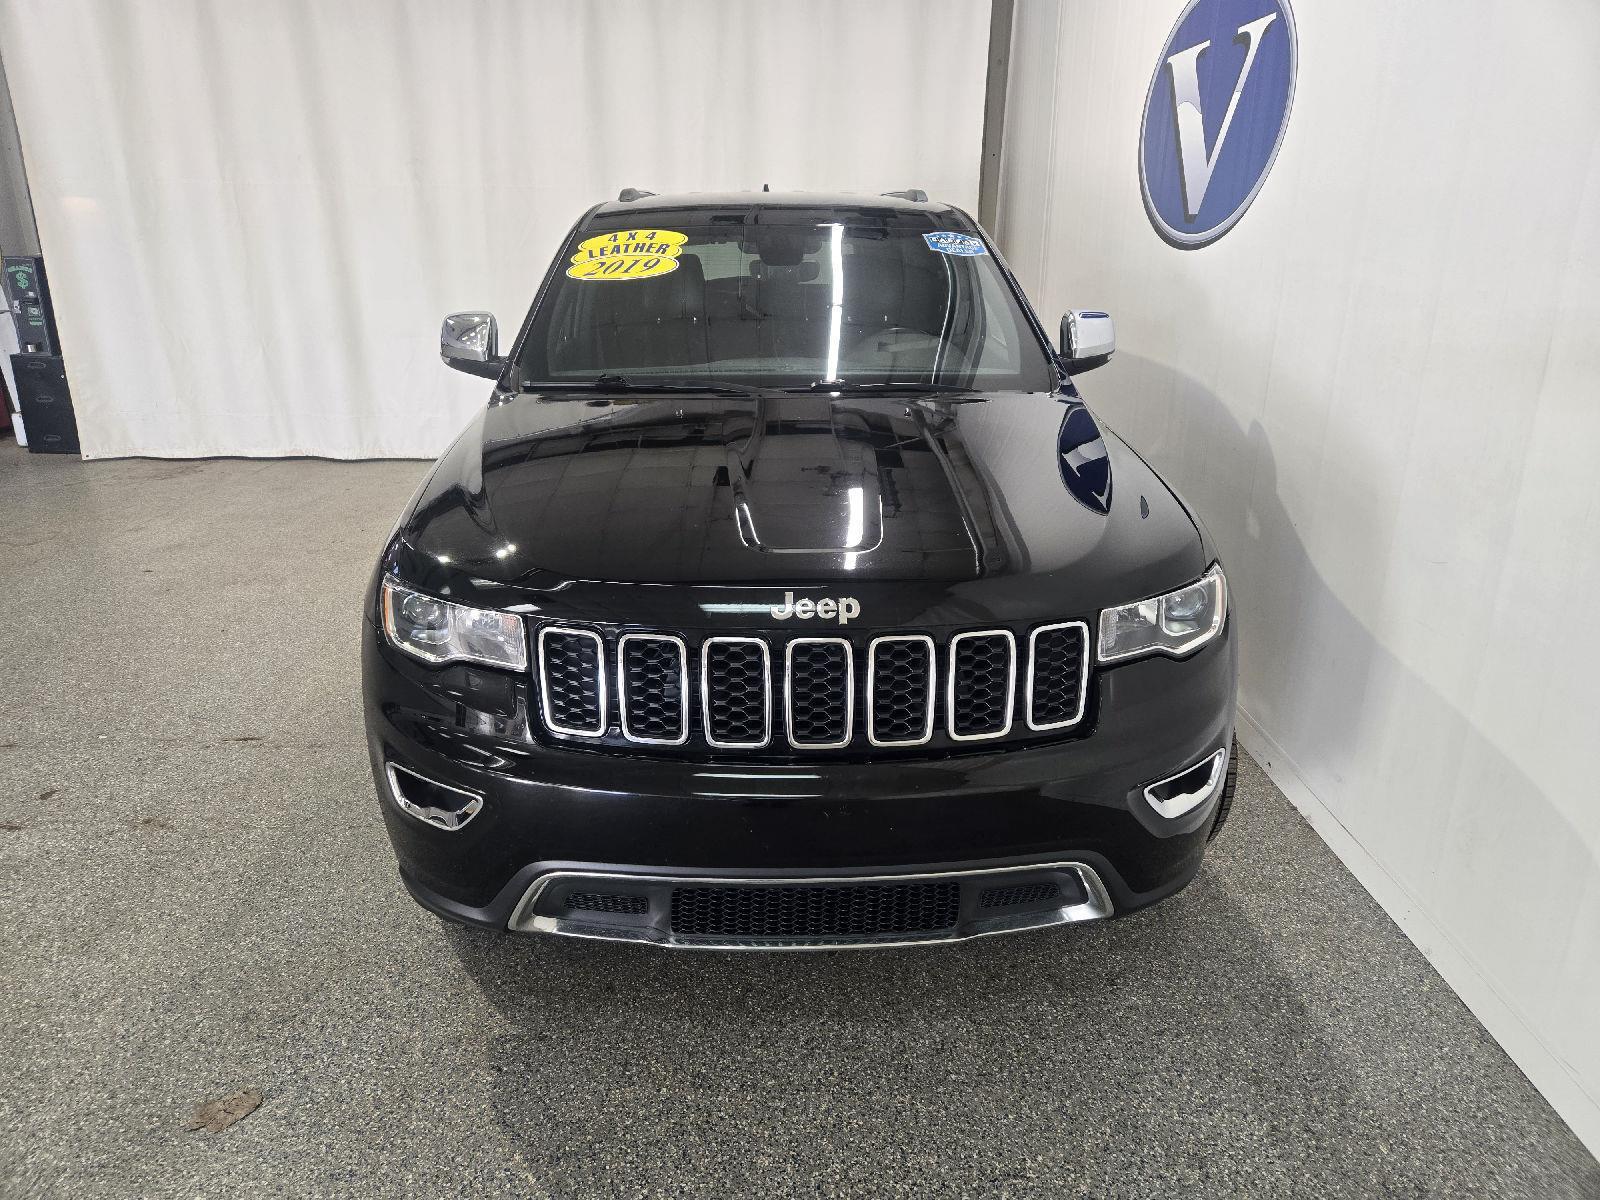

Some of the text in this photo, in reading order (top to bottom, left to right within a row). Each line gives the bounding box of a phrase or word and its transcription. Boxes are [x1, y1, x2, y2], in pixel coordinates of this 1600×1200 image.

[1166, 12, 1277, 215] V
[608, 231, 657, 243] 4 X 4
[588, 243, 670, 259] LEATHER
[583, 258, 661, 276] 2019
[769, 591, 861, 625] Jeep
